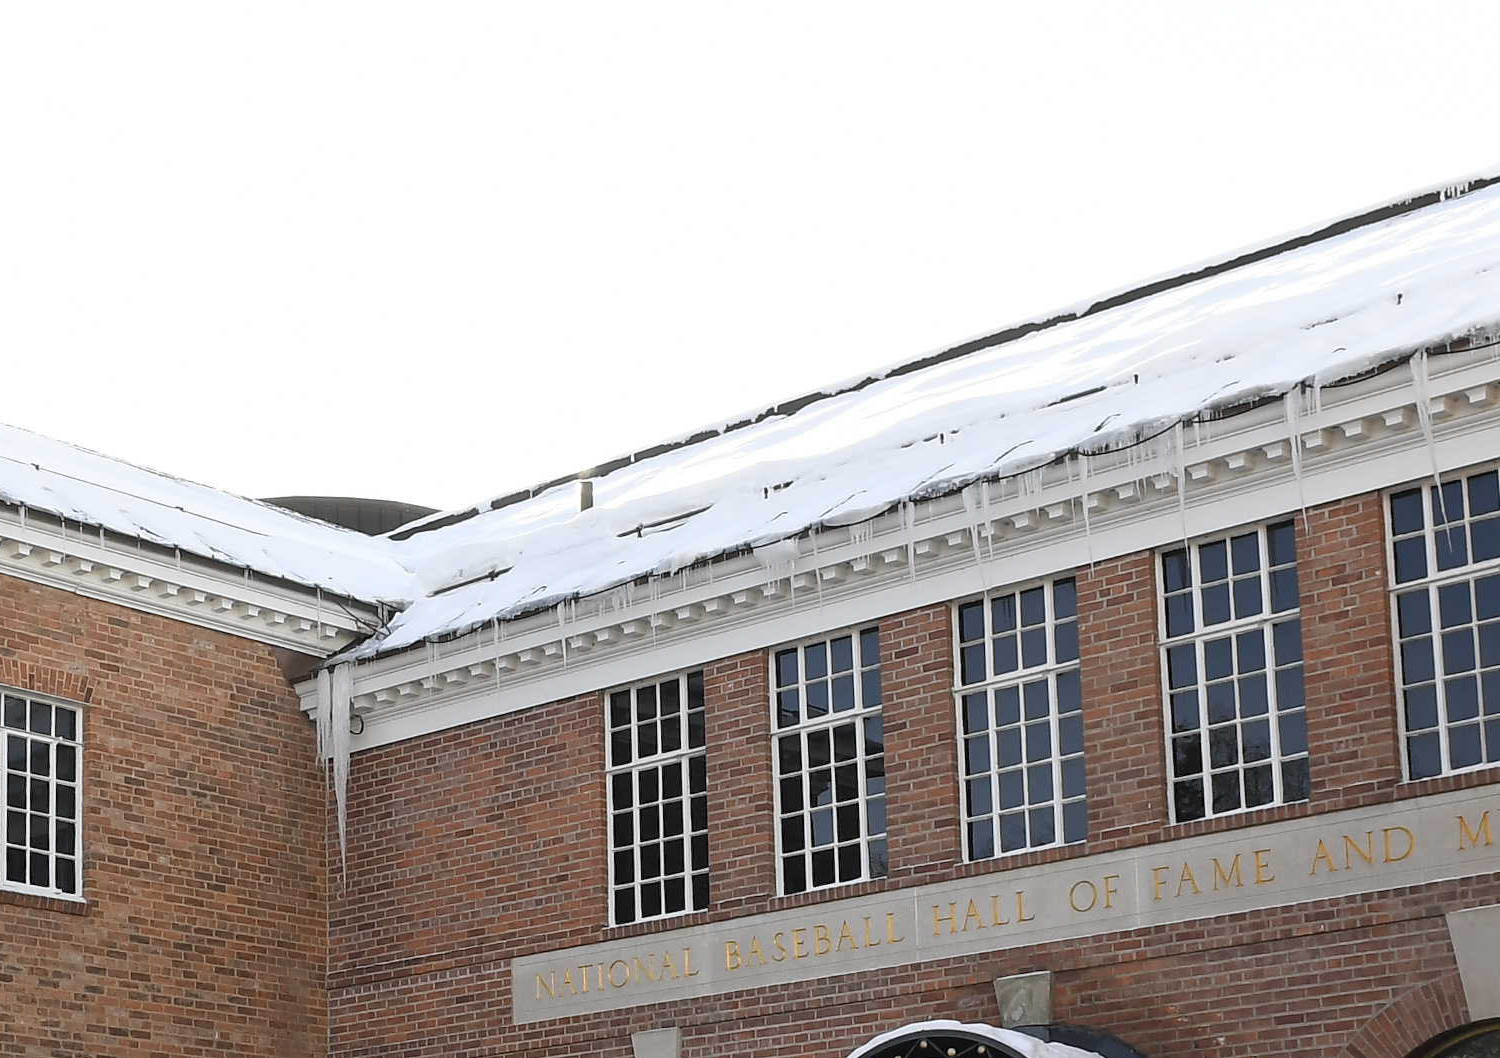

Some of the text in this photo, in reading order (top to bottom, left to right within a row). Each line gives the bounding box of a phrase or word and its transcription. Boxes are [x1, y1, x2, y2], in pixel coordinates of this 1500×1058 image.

[535, 809, 1500, 1001] NATIONAL BASEBALL HALL OF FAME AND M
